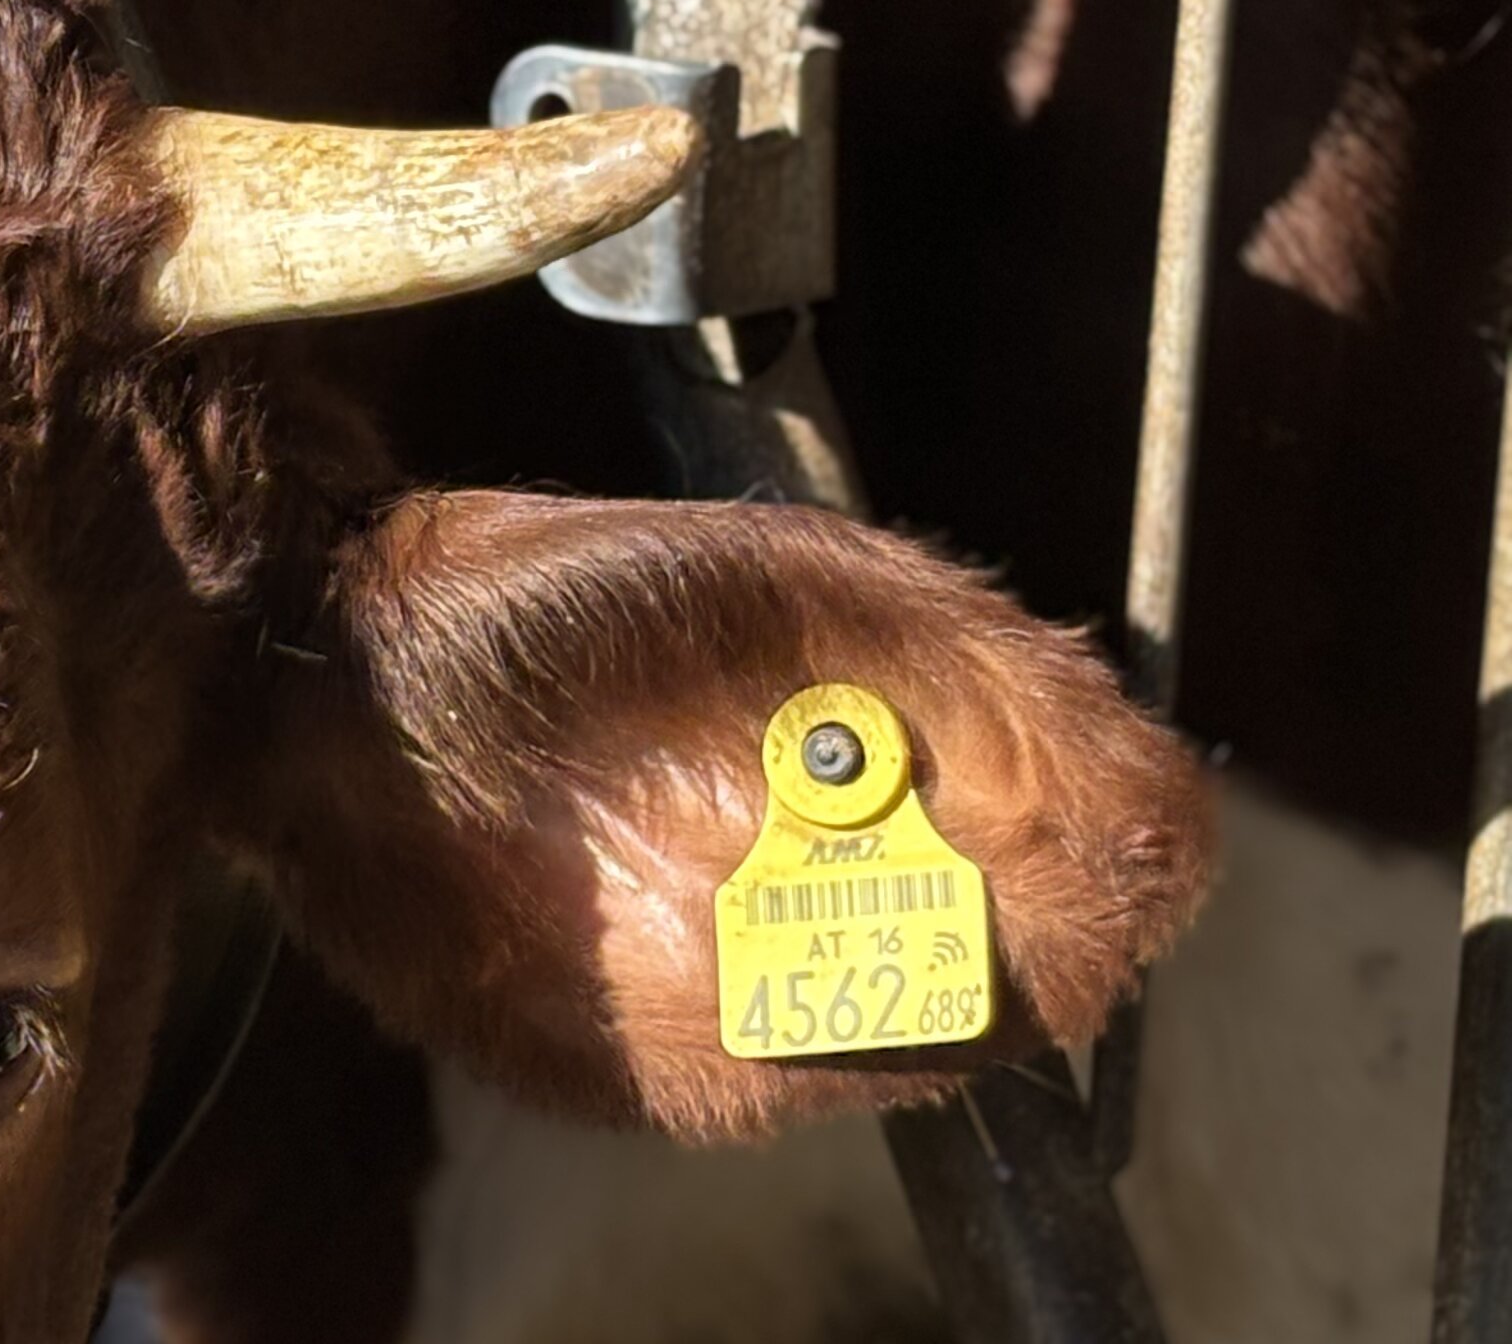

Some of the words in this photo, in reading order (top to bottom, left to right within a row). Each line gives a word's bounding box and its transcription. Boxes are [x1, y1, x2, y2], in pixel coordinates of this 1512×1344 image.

[808, 931, 846, 961] AT
[868, 925, 904, 955] 16
[738, 963, 907, 1050] 4562
[918, 987, 975, 1035] 689
